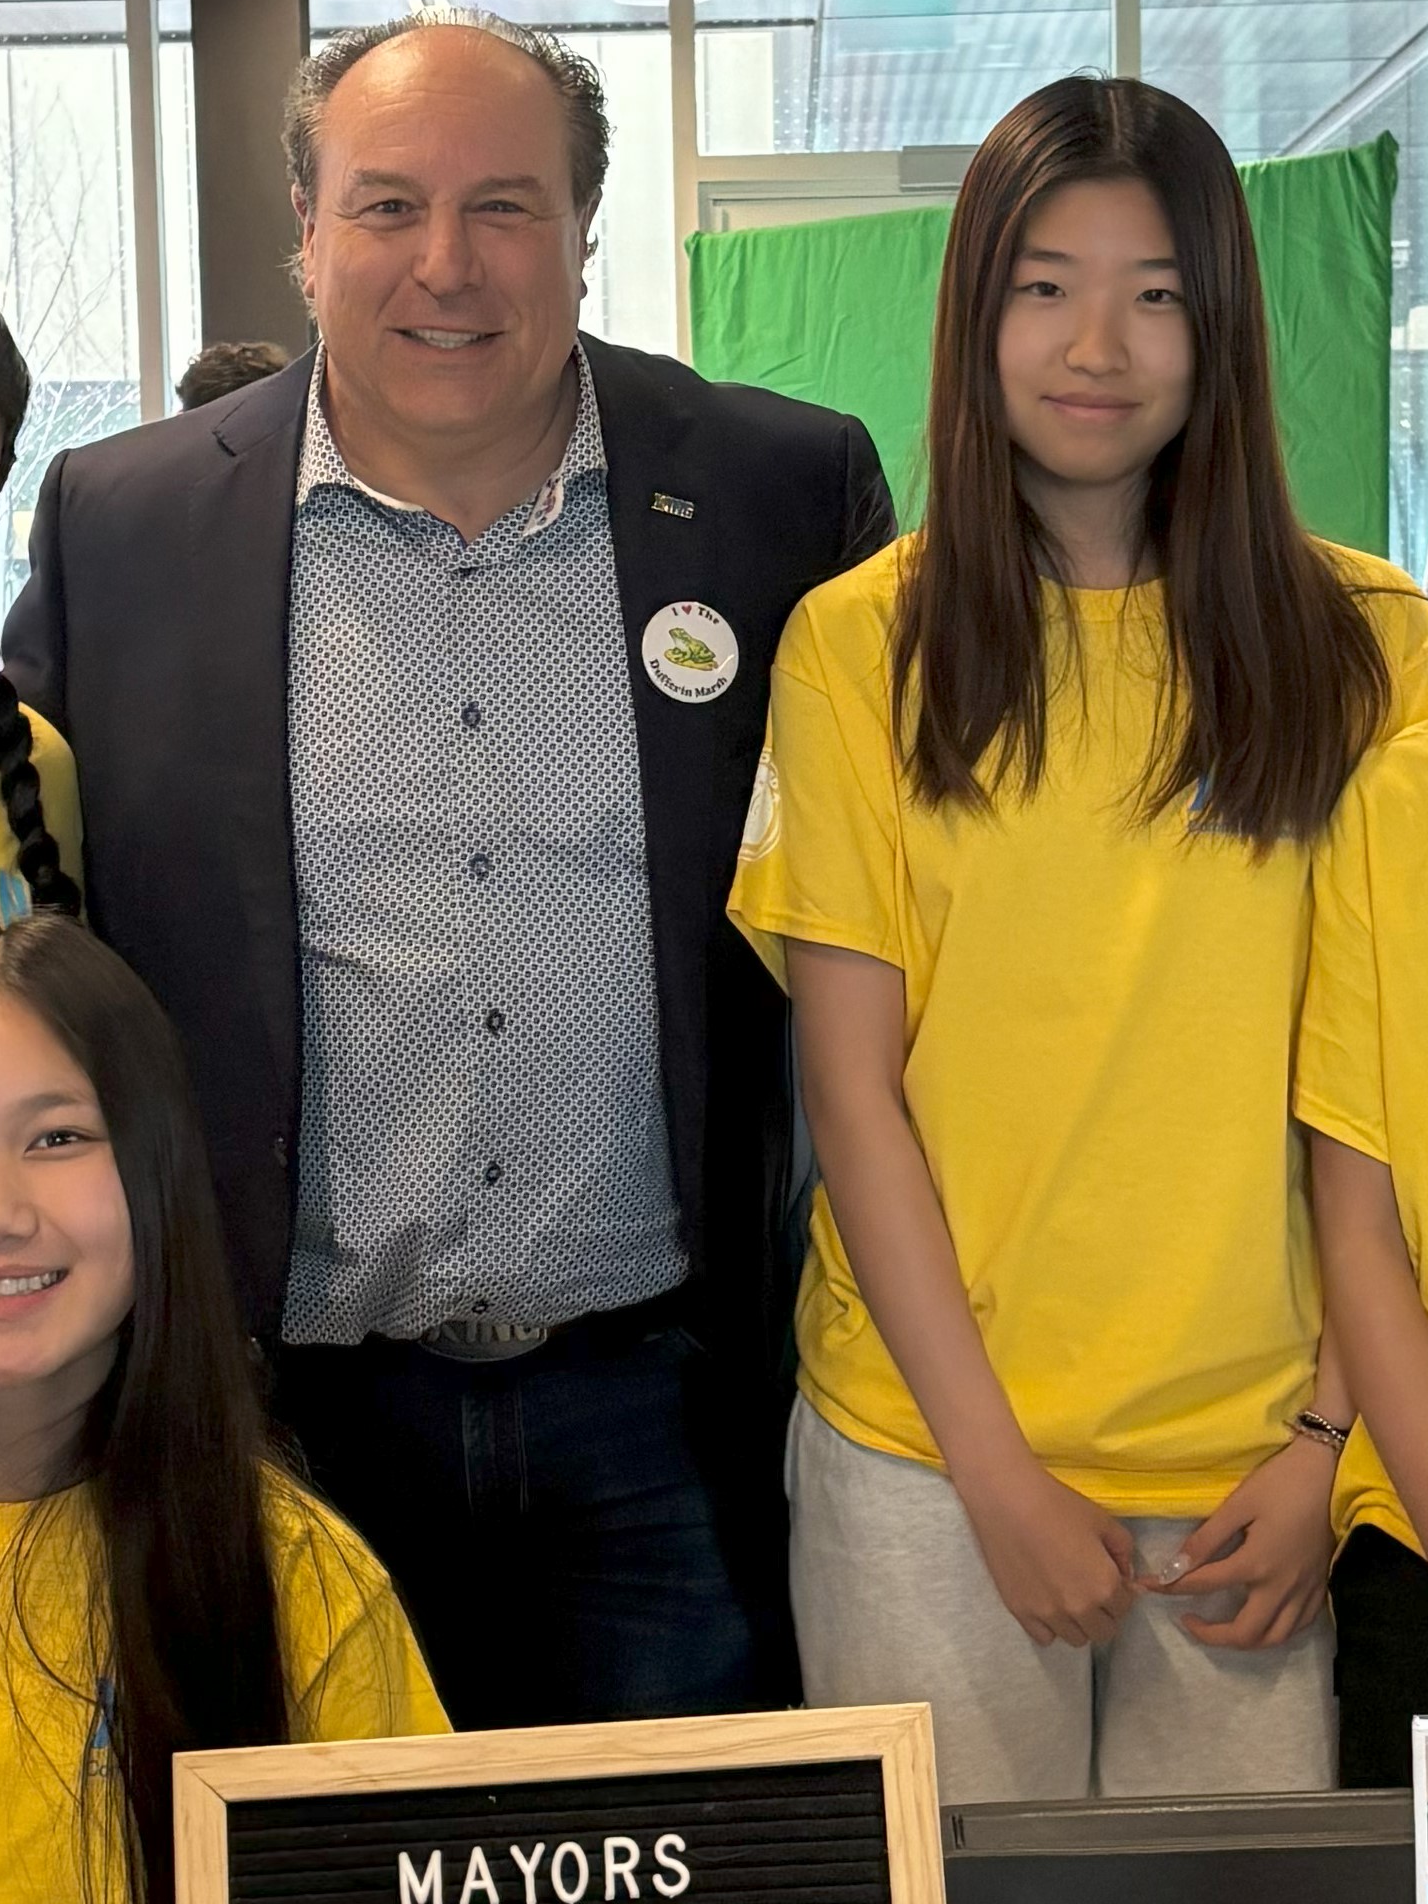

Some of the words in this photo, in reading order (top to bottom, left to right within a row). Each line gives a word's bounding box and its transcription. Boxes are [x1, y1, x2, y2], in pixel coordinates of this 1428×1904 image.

[671, 607, 679, 617] I
[697, 606, 721, 625] The
[649, 658, 693, 698] Dufferin
[694, 676, 728, 698] Marsh
